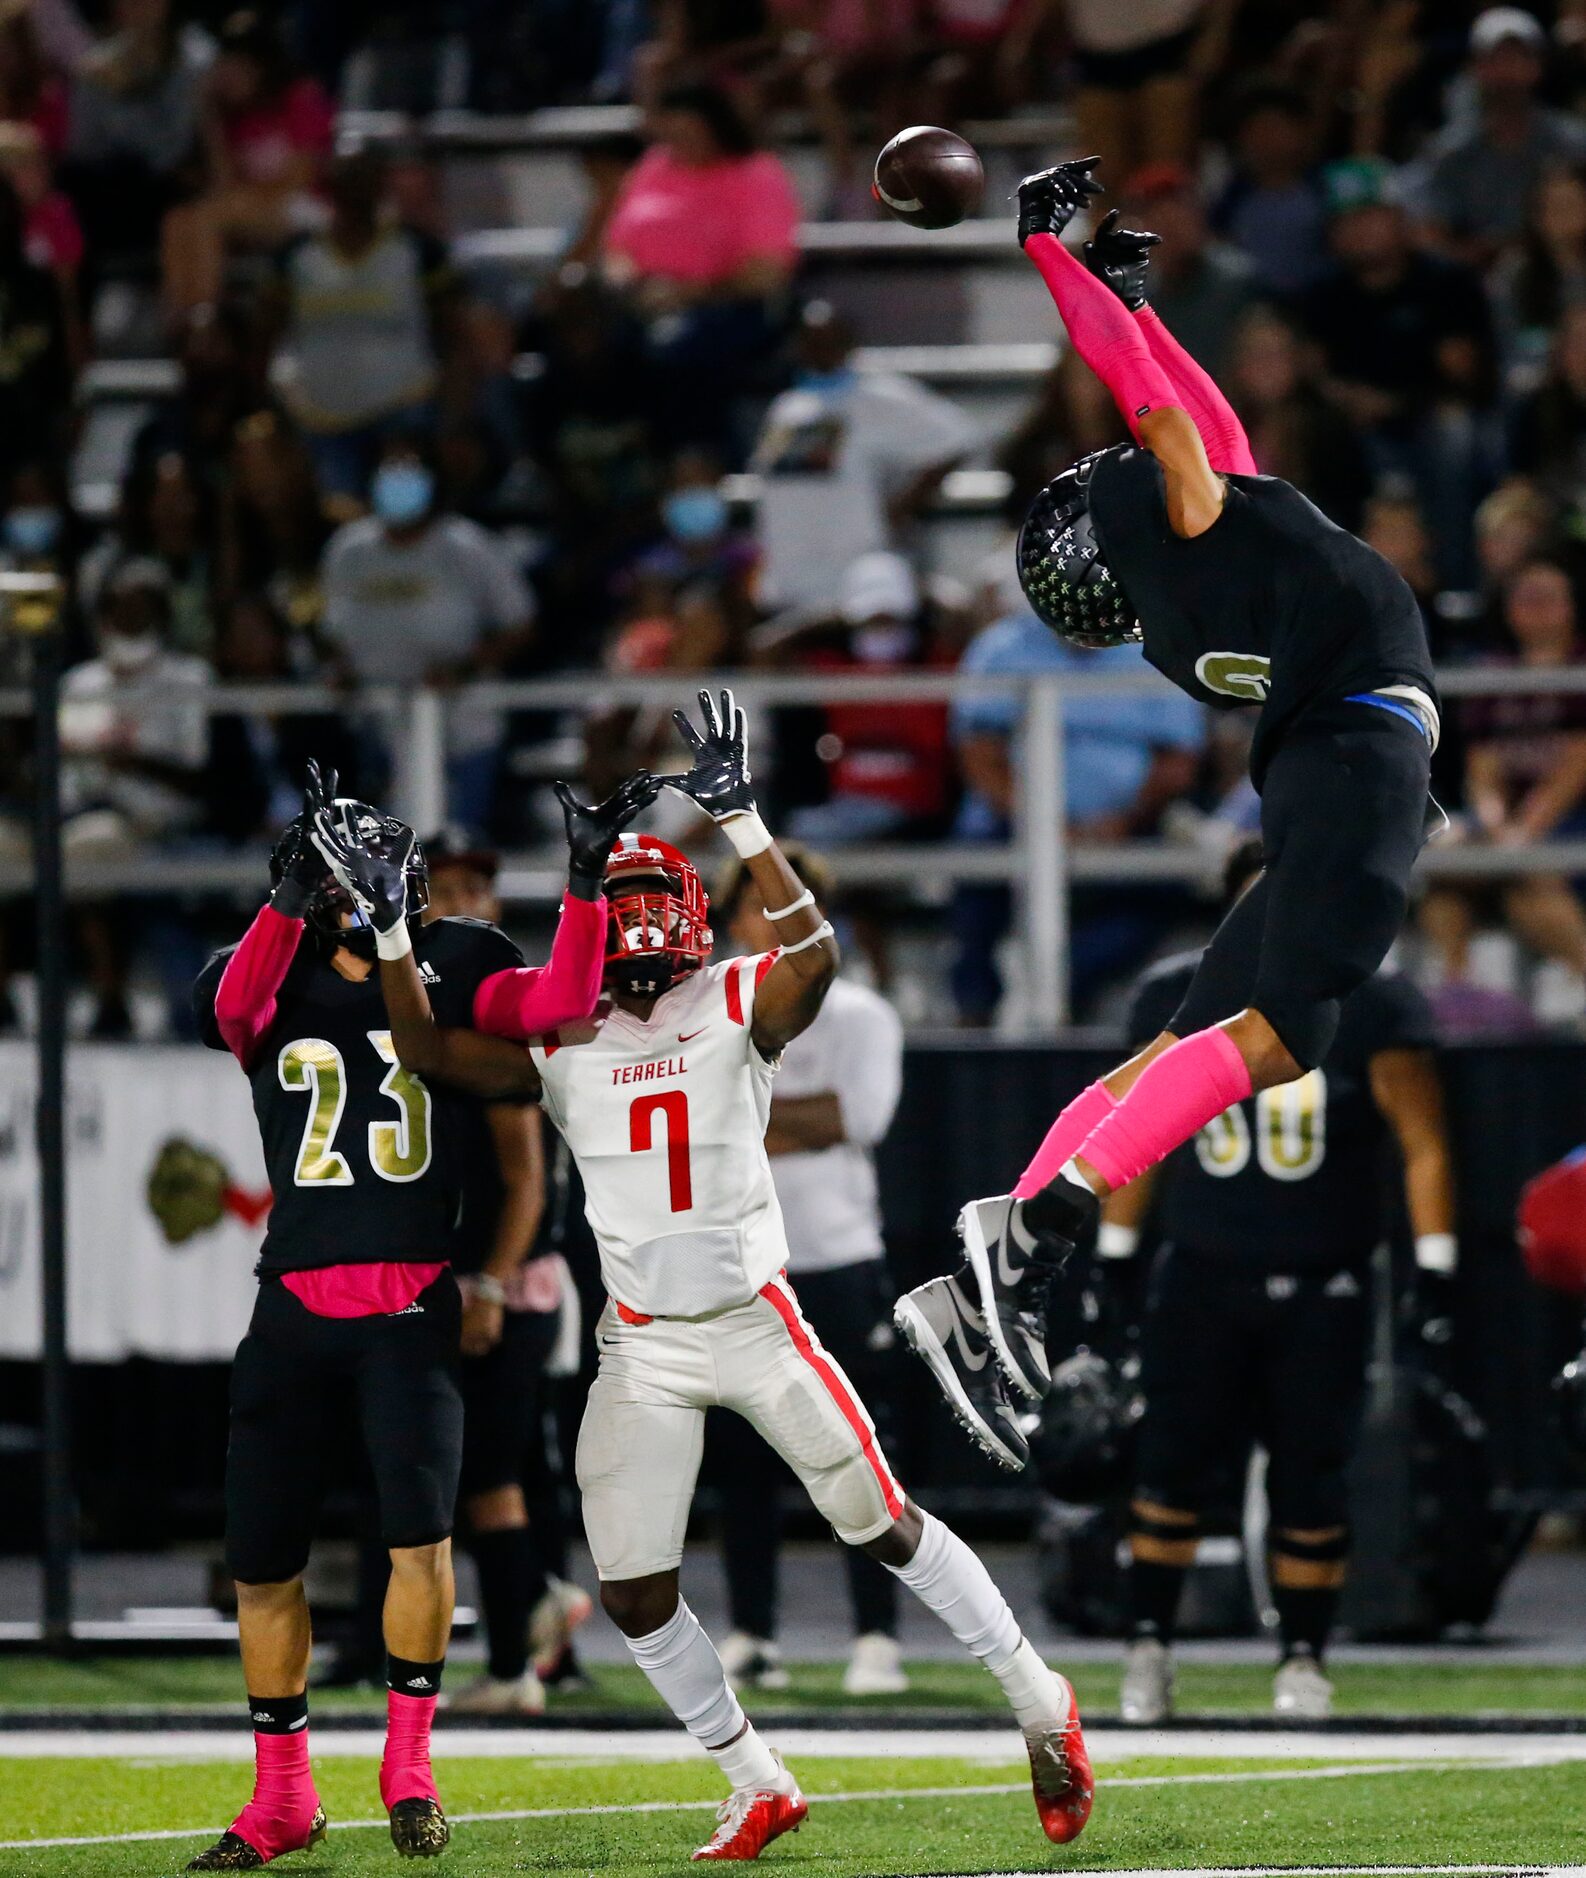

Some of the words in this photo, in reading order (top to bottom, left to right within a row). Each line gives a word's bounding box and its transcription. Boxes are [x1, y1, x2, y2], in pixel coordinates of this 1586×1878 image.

[277, 1029, 433, 1187] 23
[612, 1056, 688, 1085] TERRELL
[629, 1089, 693, 1213] 7
